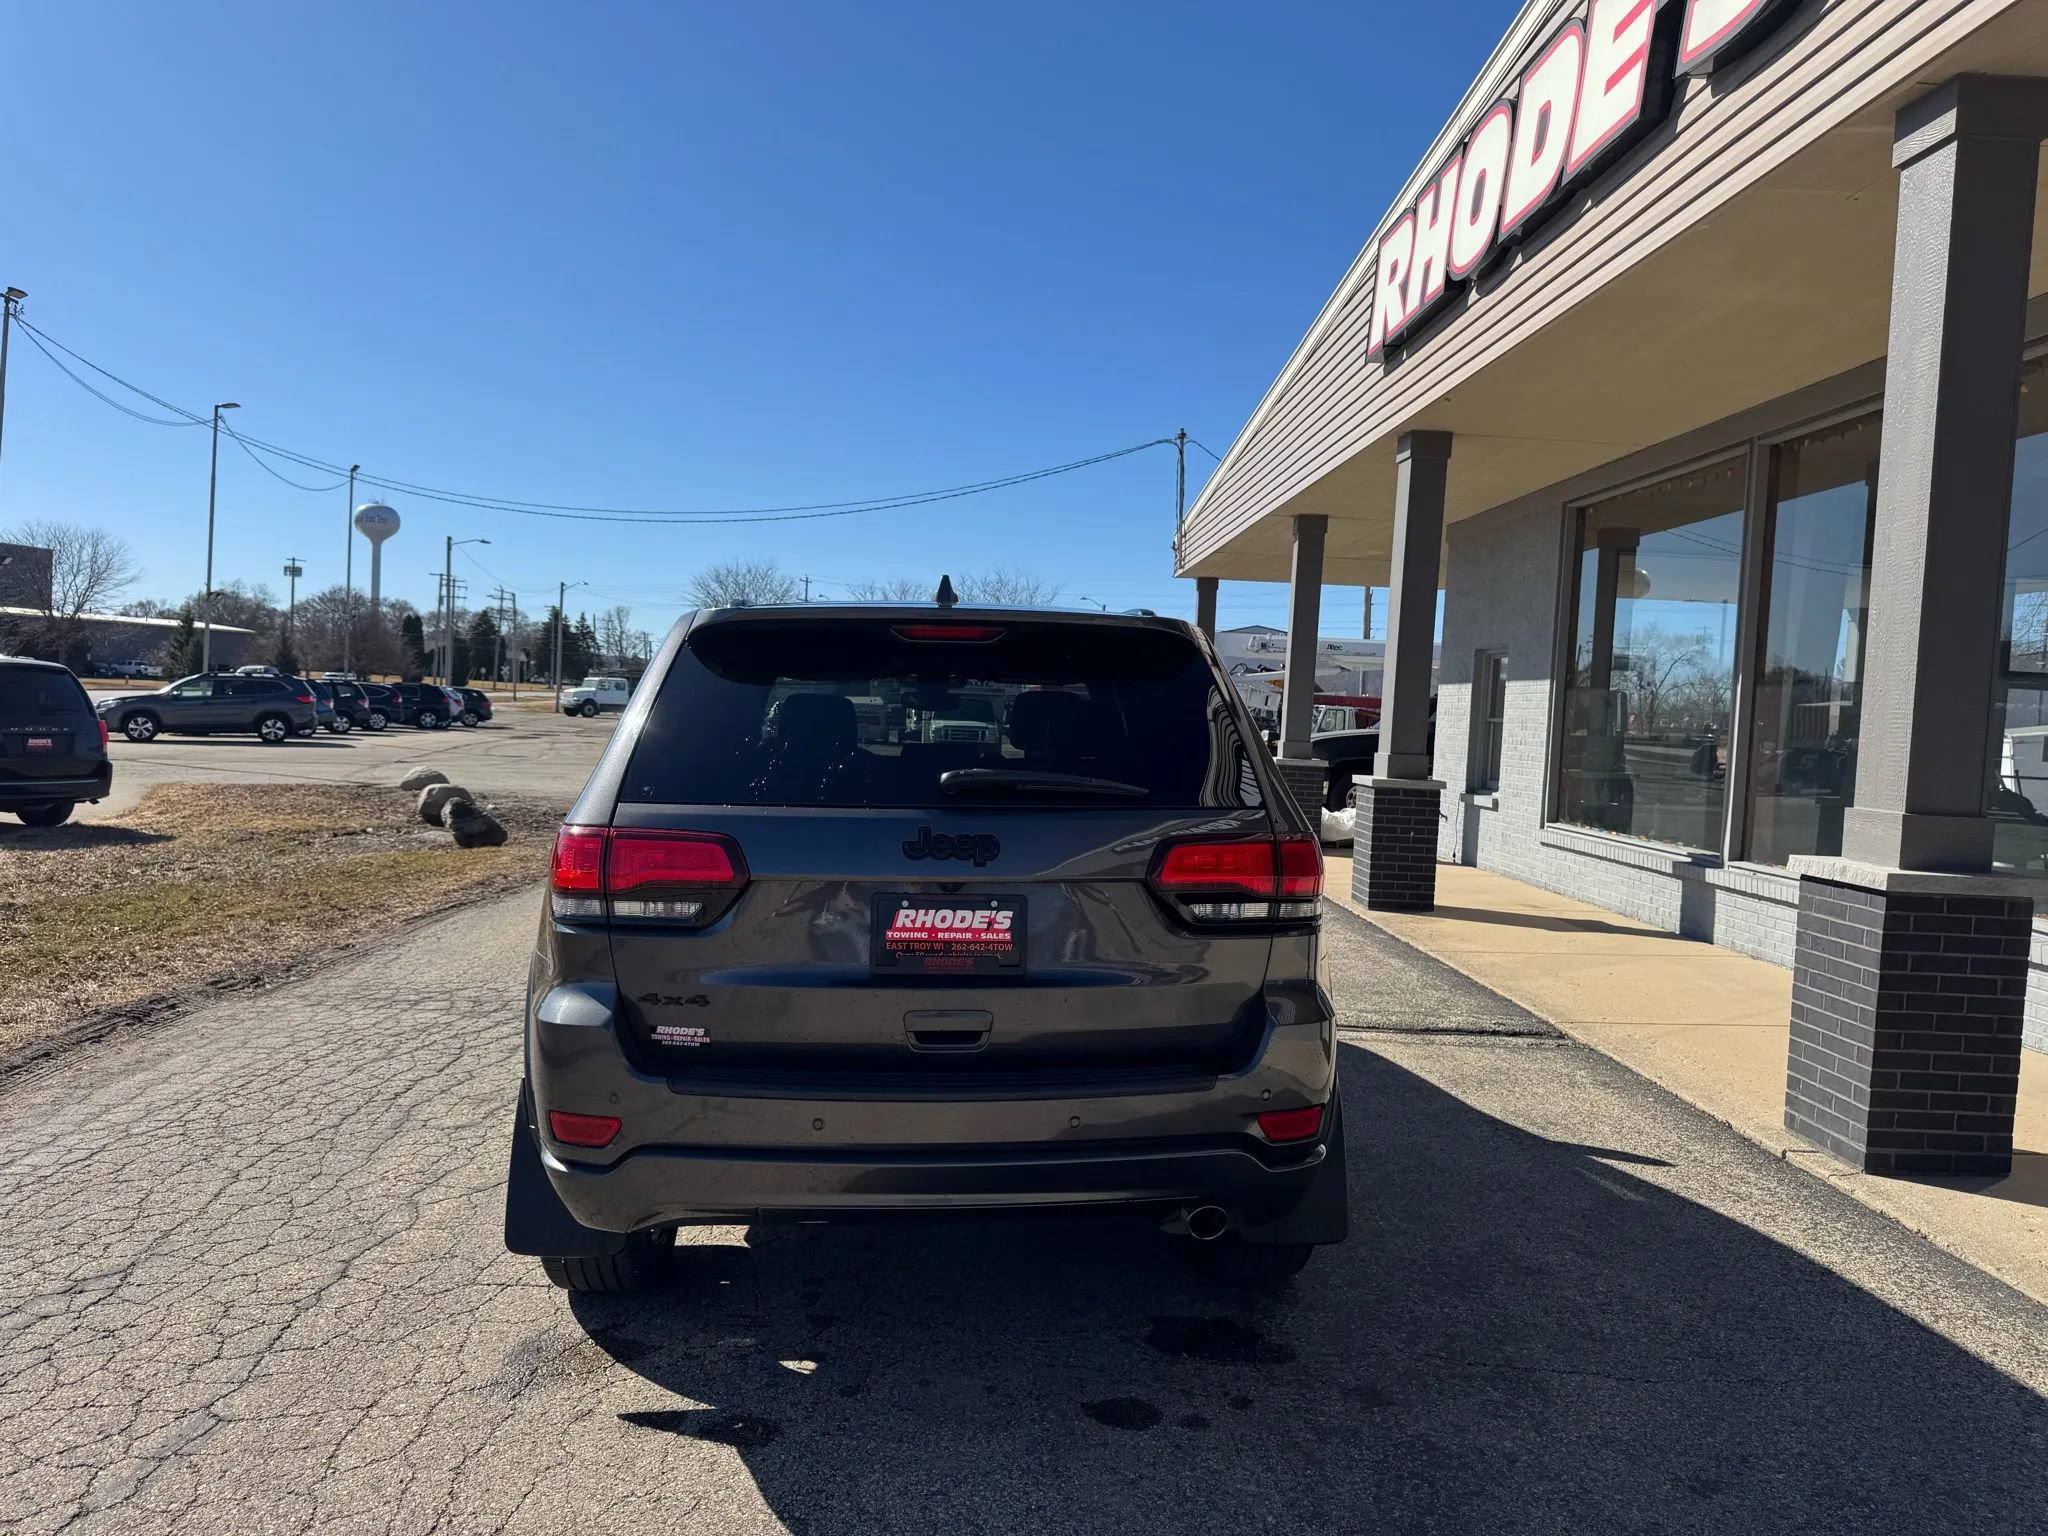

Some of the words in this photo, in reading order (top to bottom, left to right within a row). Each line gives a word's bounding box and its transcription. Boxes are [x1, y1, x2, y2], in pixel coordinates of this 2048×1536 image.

[902, 825, 1000, 867] Jeep
[894, 909, 1013, 930] RHODE'S
[886, 931, 928, 939] TOWING
[951, 943, 1013, 951] 262-642-4TOW
[656, 1026, 705, 1036] RHODE'S
